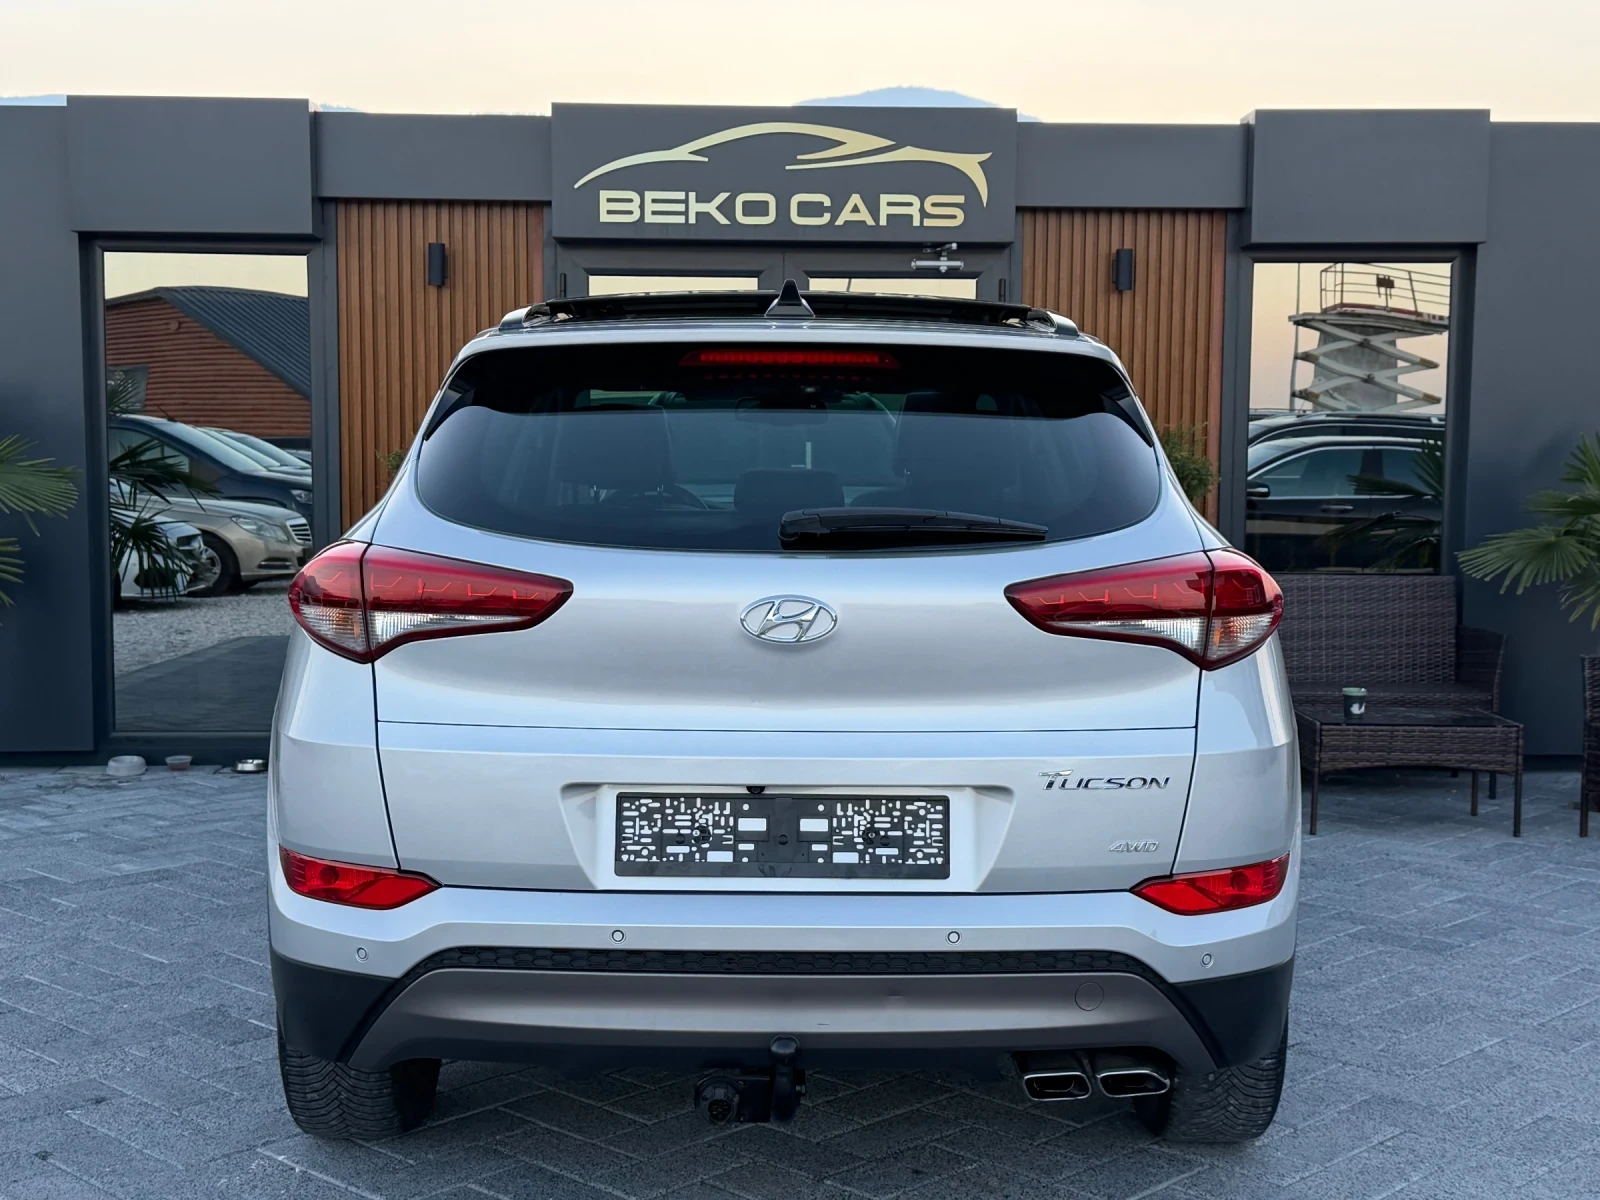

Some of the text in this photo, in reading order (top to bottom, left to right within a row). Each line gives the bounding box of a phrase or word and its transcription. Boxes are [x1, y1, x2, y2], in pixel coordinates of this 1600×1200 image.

[599, 190, 965, 227] BEKO CARS
[1038, 769, 1170, 790] TUCSON
[1109, 840, 1159, 852] 4WD
